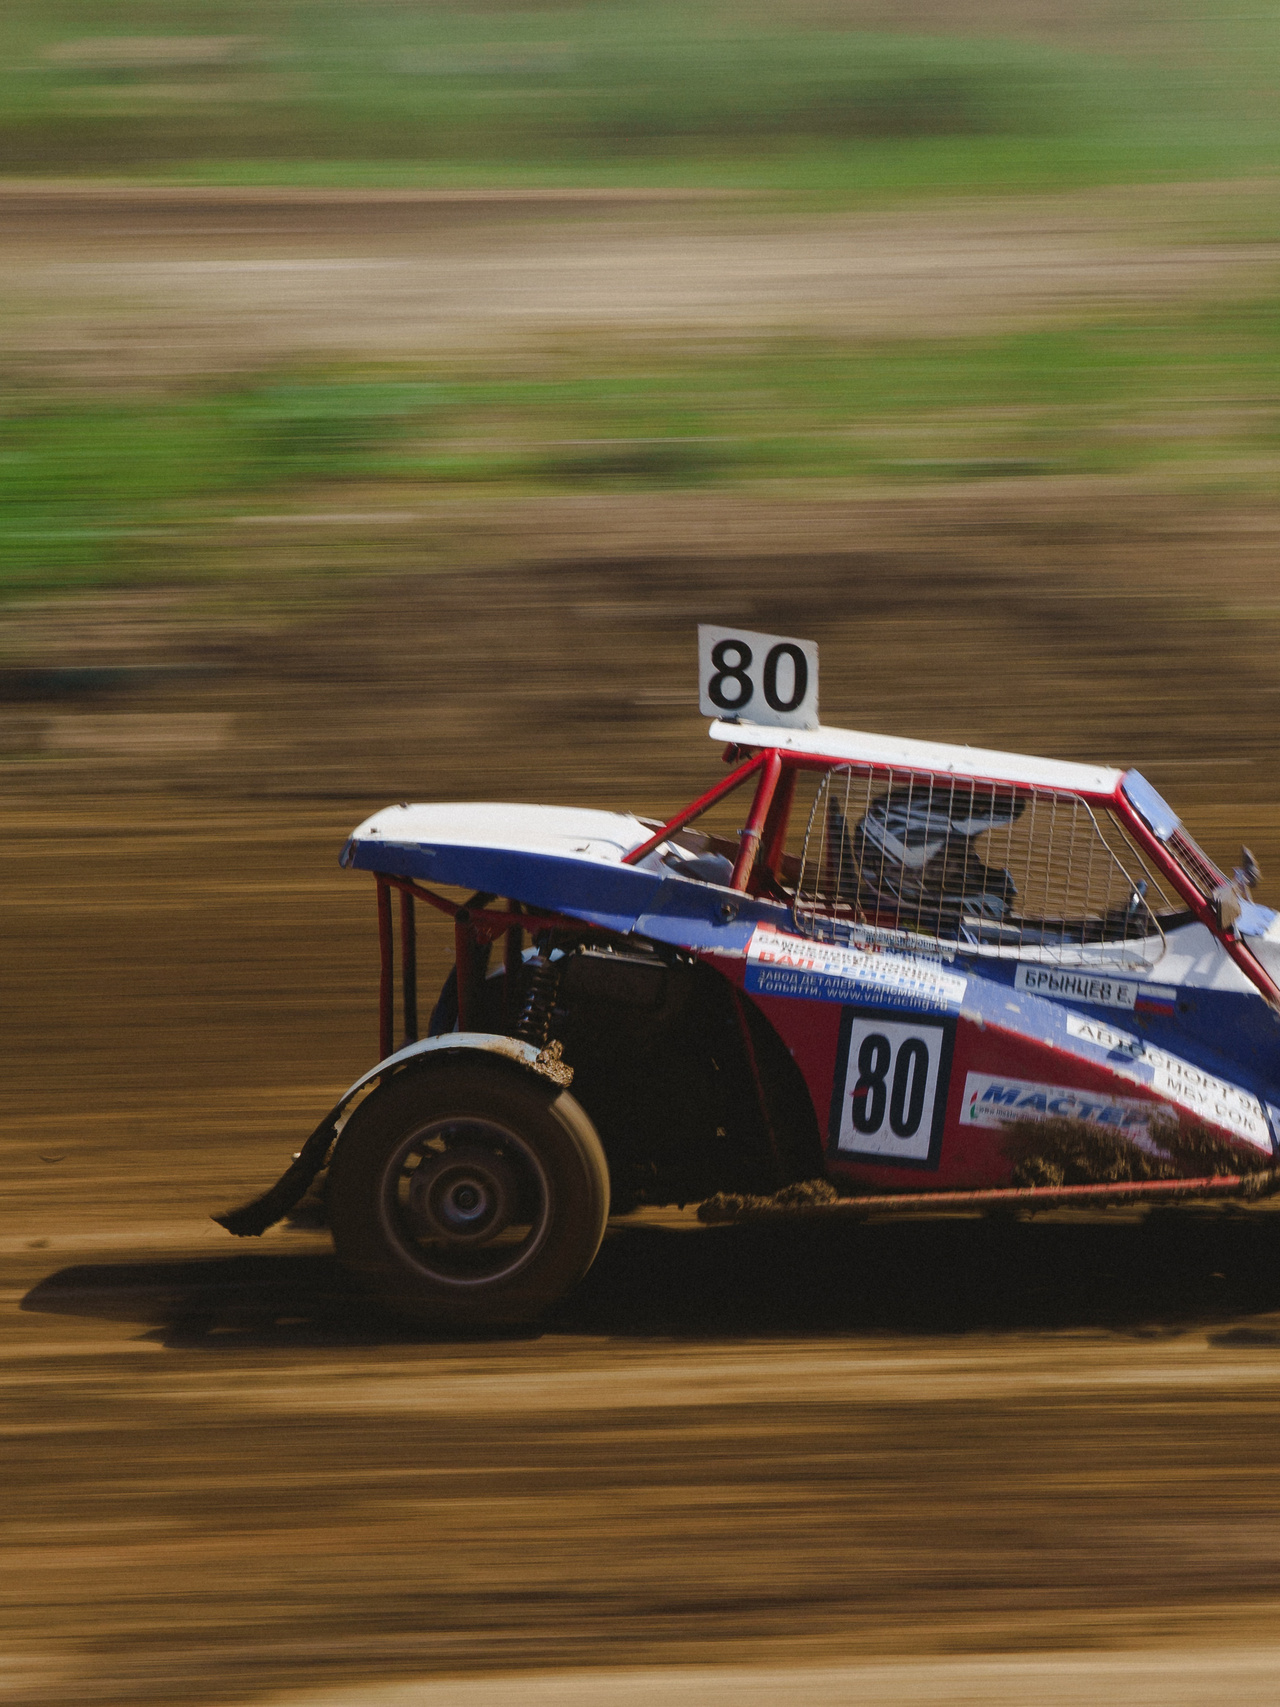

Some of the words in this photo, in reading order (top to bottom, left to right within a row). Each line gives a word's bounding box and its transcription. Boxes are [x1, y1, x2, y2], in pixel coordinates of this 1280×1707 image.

[708, 638, 808, 712] 80
[758, 969, 799, 983] ЗАВОД
[1025, 969, 1112, 998] БРЫНЦЕВ
[852, 1032, 929, 1140] 80
